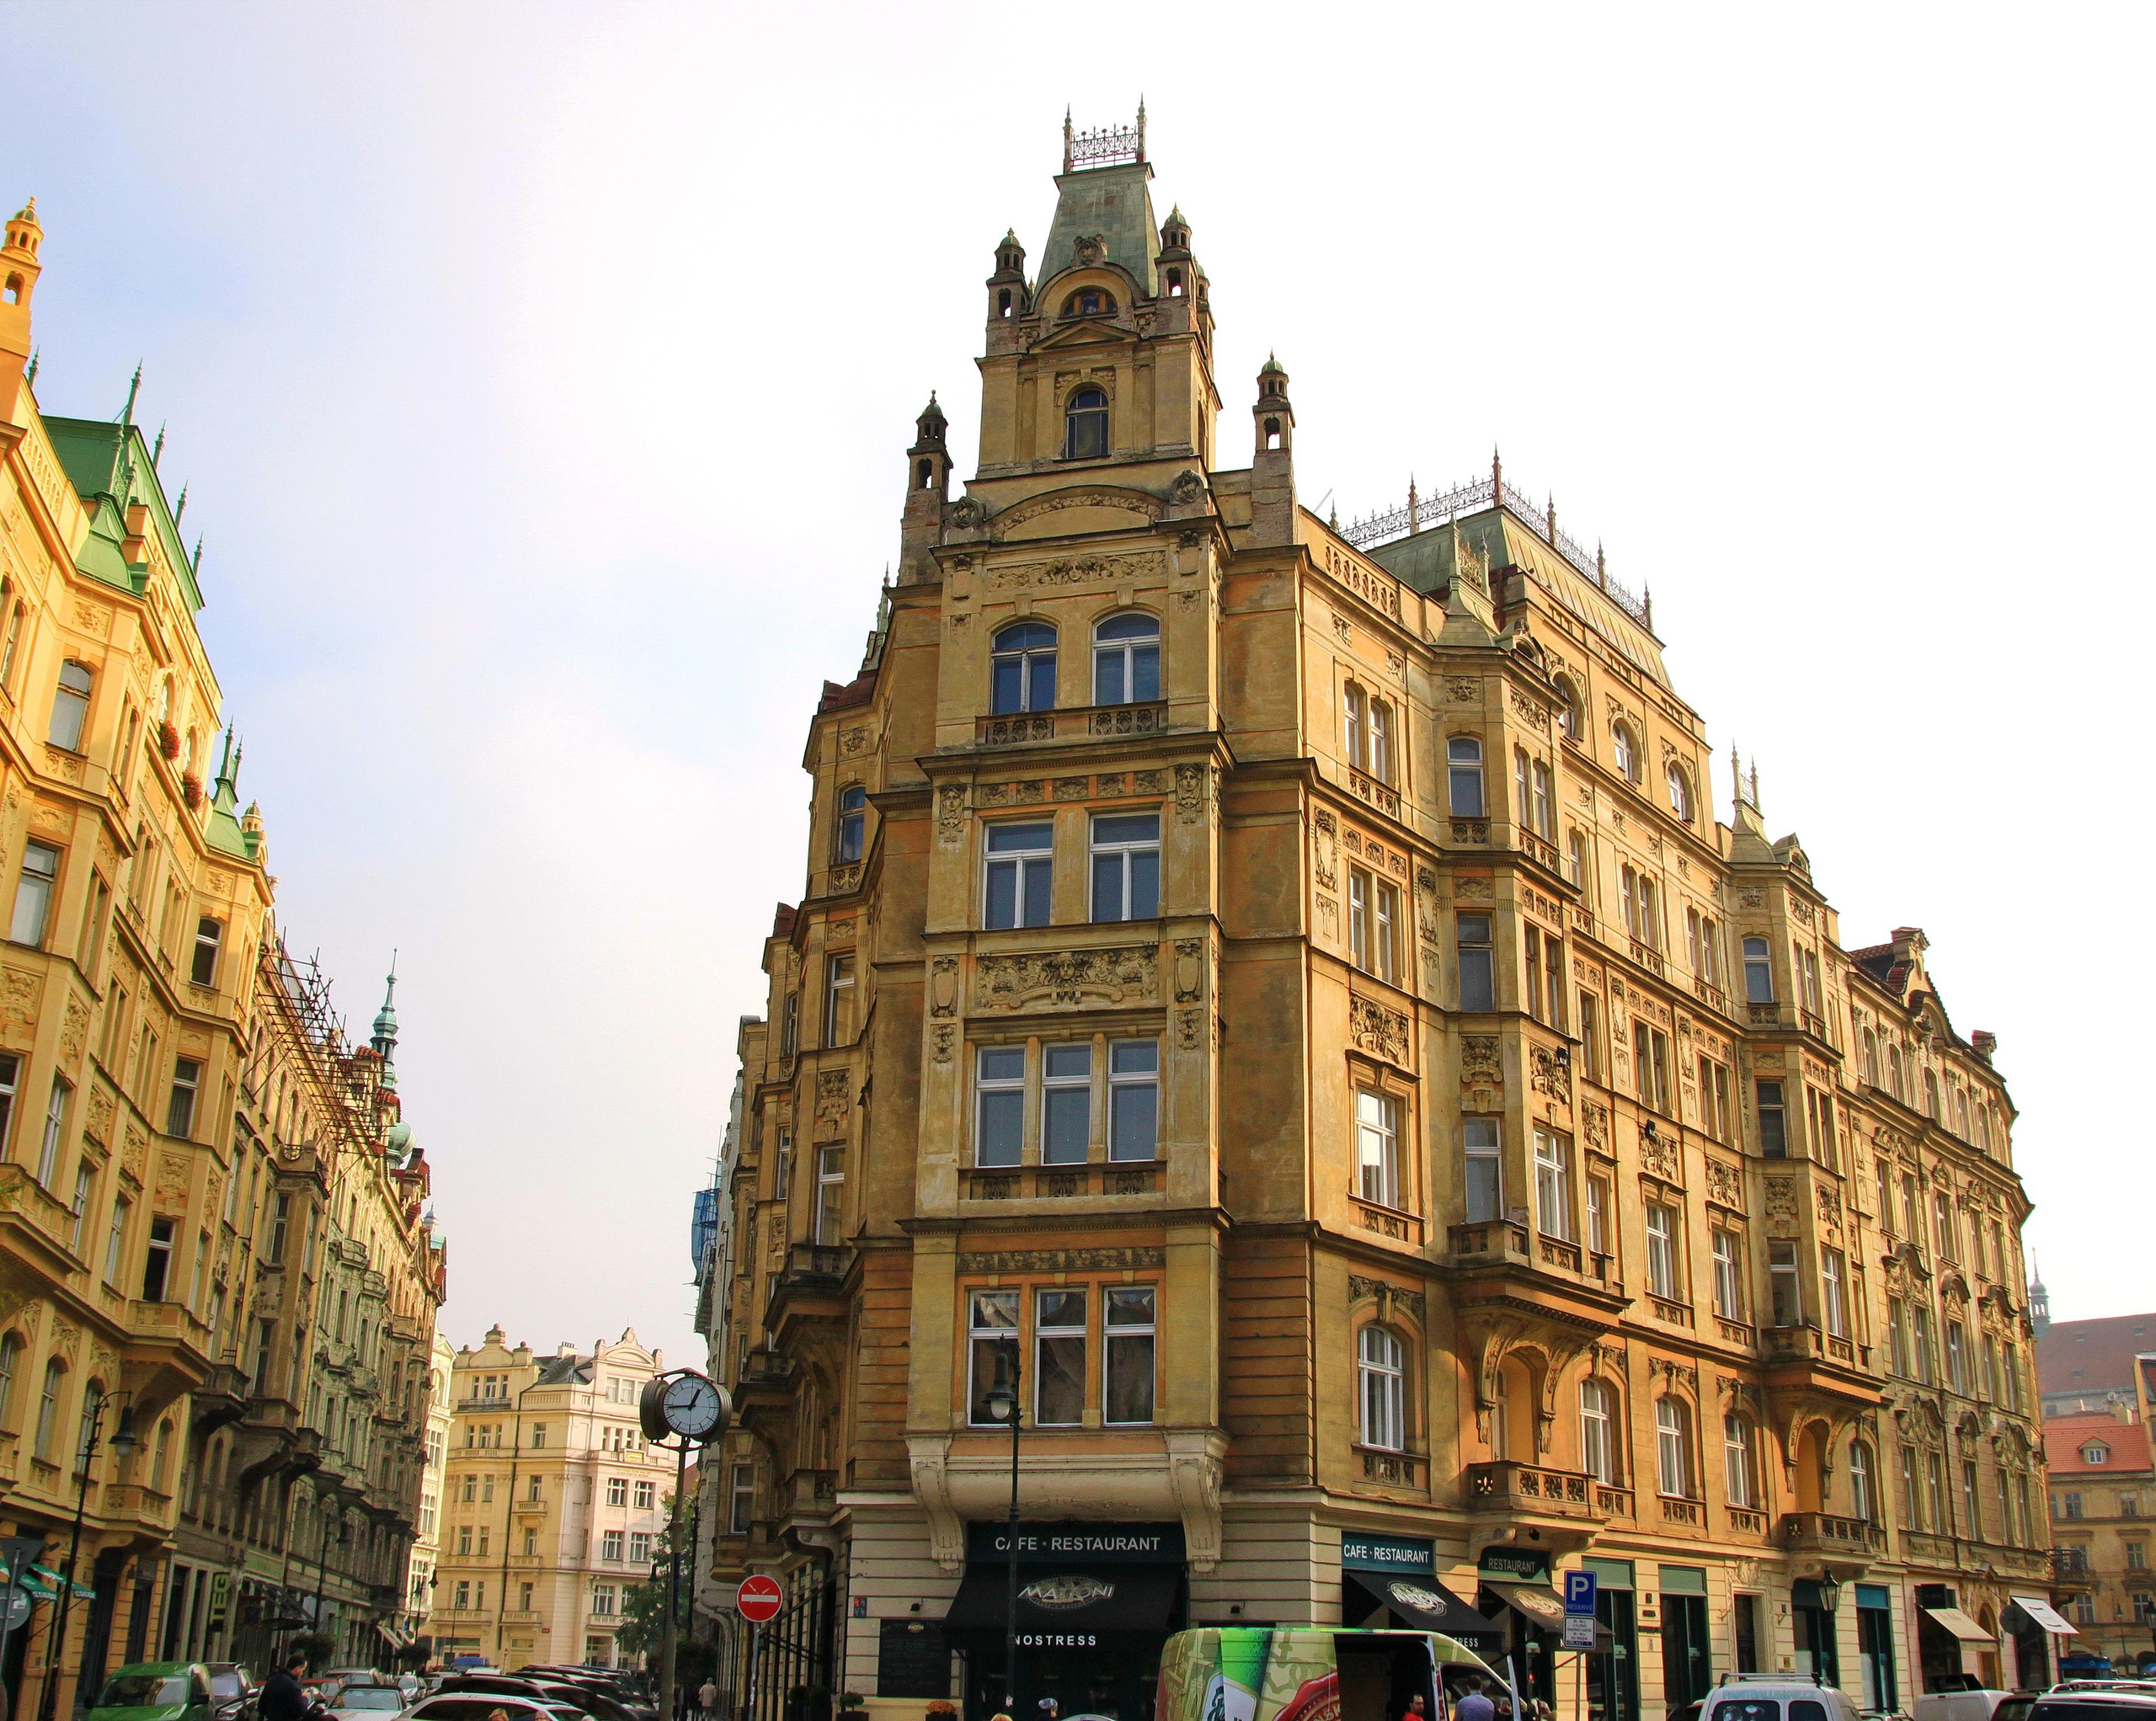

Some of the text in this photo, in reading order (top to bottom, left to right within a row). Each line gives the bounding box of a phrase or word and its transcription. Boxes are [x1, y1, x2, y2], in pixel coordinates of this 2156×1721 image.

[1051, 1537, 1161, 1551] RESTAURANT
[1343, 1543, 1429, 1564] CAFE RESTAURANT
[1487, 1557, 1536, 1574] RESTAURANT
[1571, 1576, 1589, 1601] P
